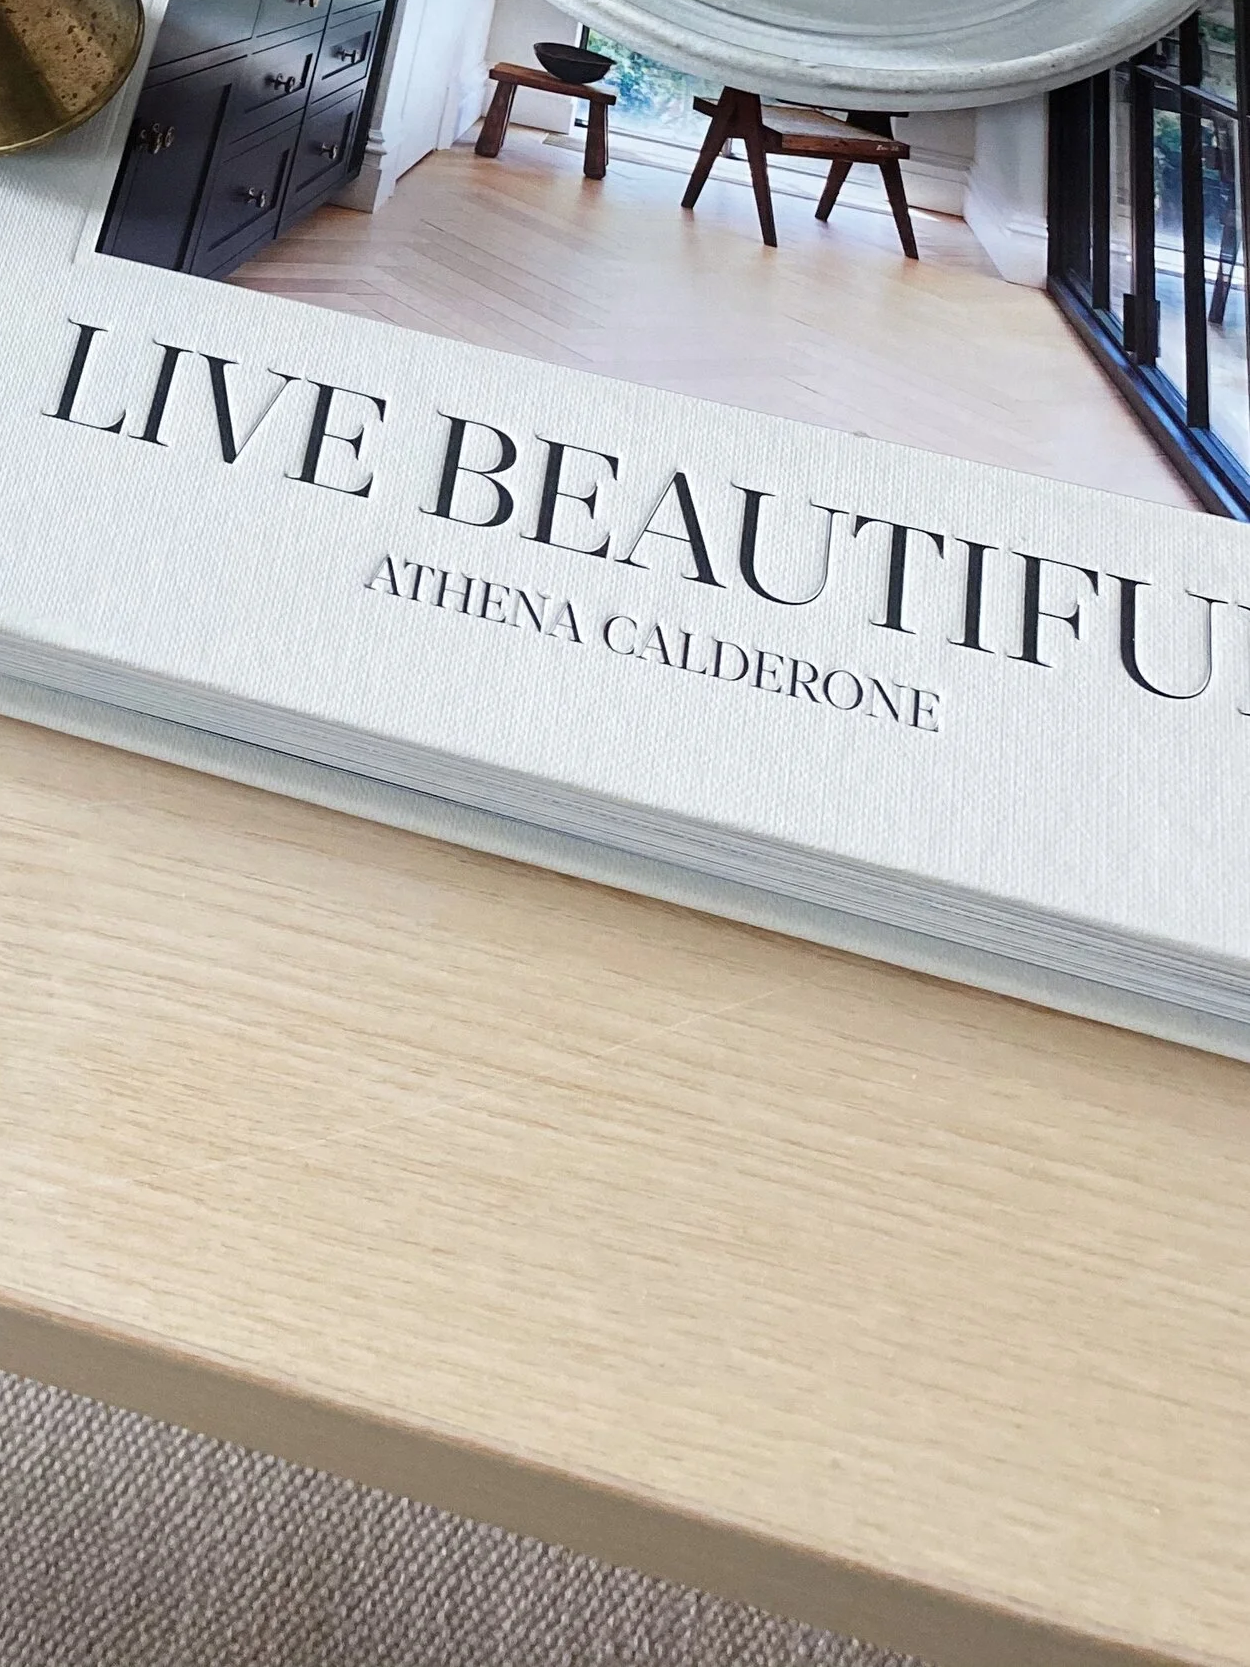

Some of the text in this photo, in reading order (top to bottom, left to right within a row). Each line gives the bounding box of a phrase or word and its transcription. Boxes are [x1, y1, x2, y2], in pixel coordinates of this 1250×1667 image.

[41, 317, 1250, 717] LIVE BEAUTIFU
[364, 553, 942, 734] ATHENA CALDERONE
